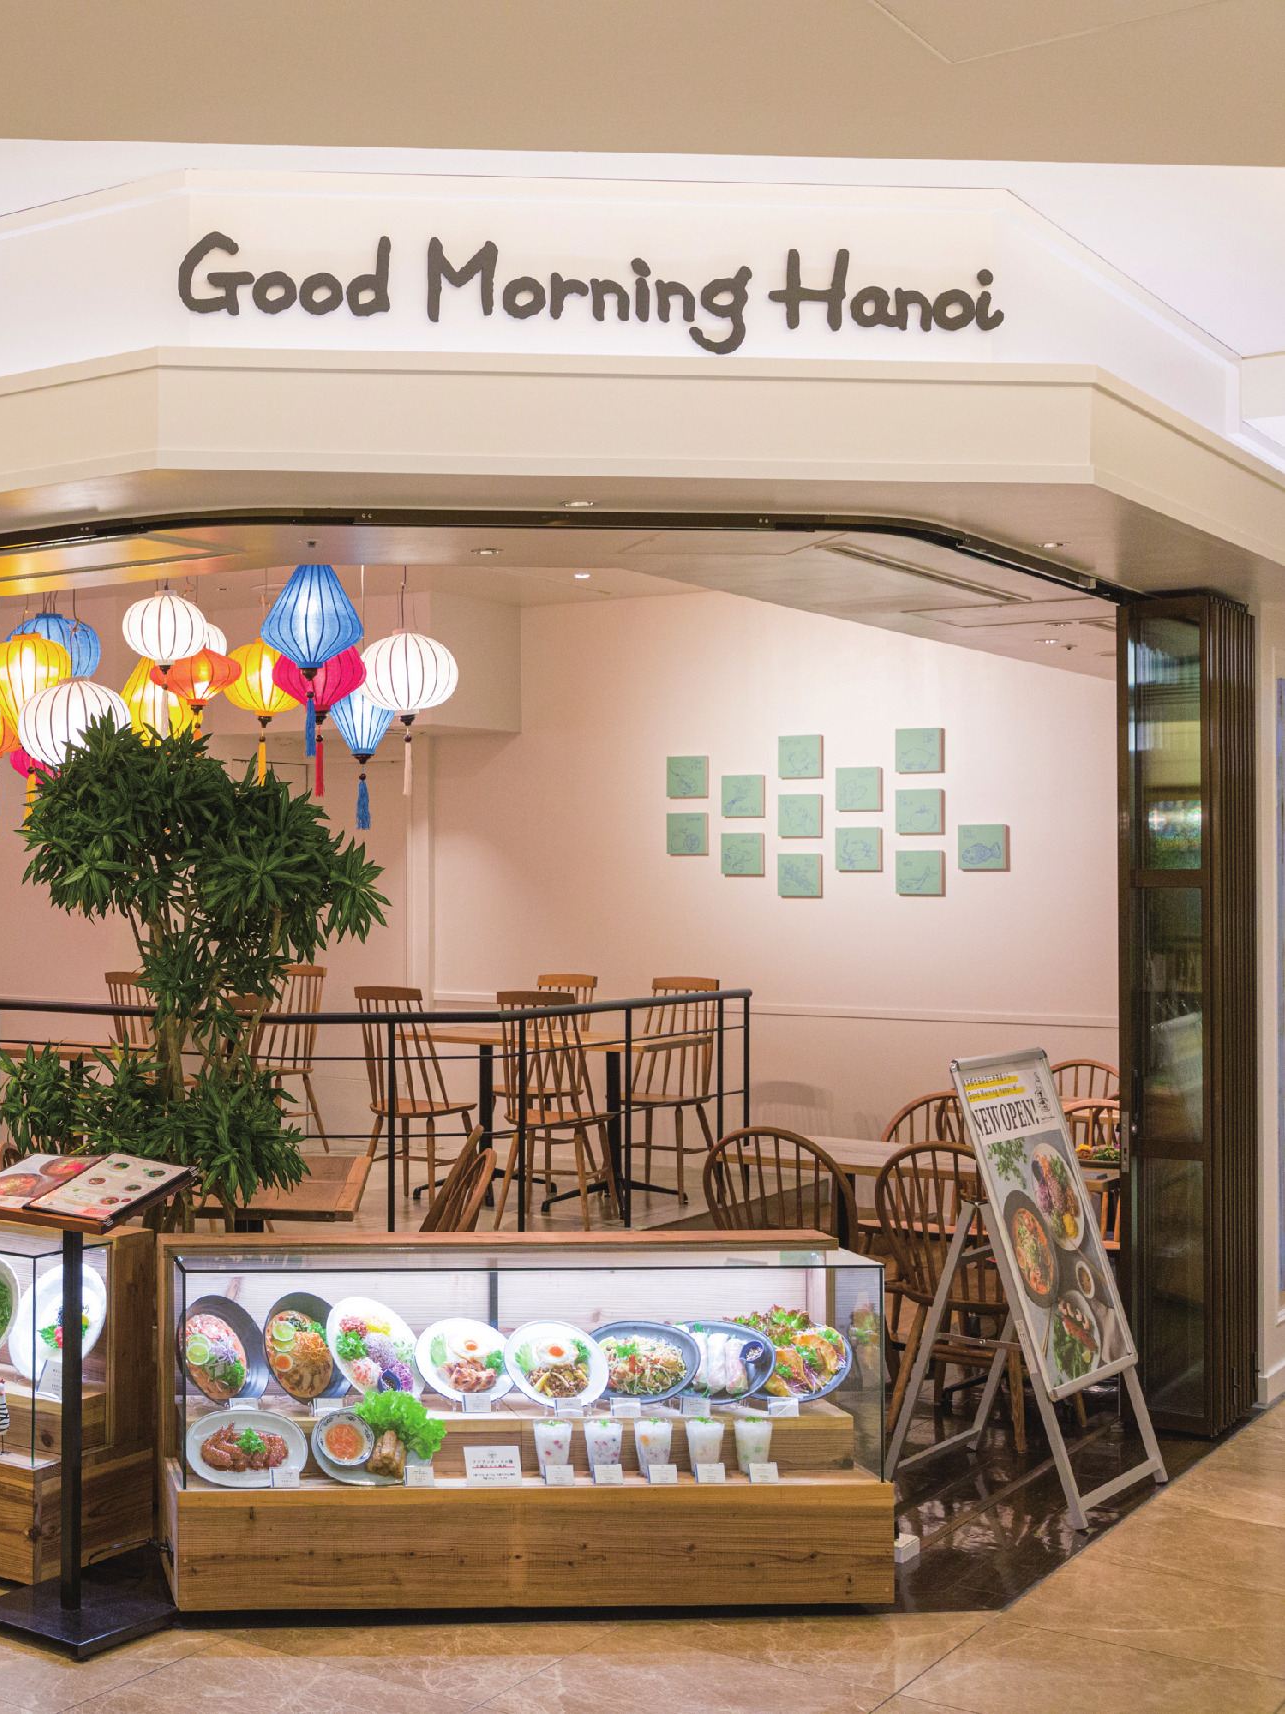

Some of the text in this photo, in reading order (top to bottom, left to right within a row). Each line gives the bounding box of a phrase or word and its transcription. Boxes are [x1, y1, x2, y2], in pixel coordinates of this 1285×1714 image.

[178, 231, 1004, 354] Good Morning Hanoi
